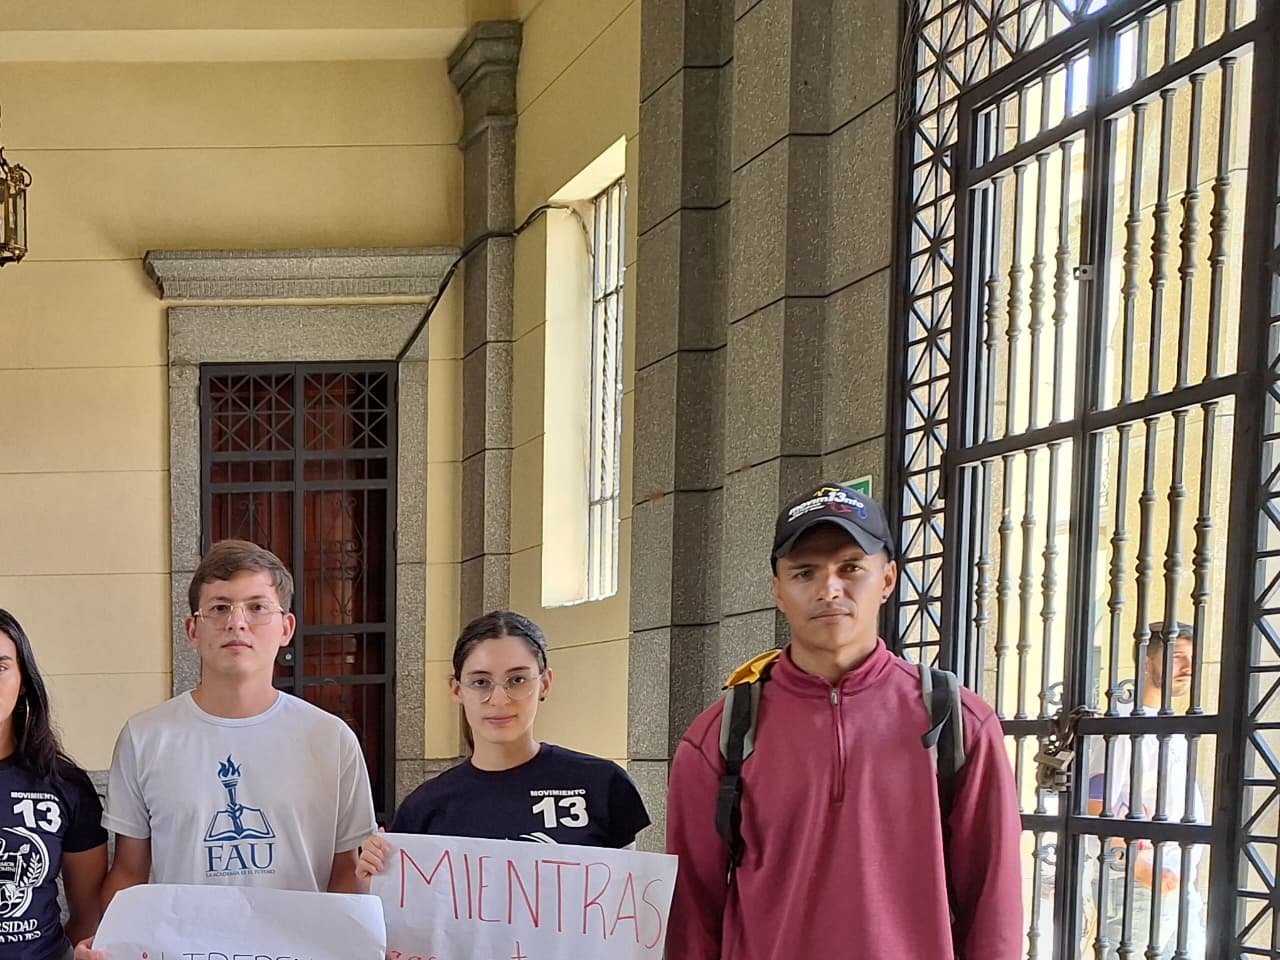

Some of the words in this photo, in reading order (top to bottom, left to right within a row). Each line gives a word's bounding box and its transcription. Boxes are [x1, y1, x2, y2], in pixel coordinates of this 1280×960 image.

[530, 789, 587, 797] MOVIMIENTO
[13, 799, 62, 833] 13
[532, 796, 589, 828] 13
[203, 842, 276, 872] FAU
[399, 848, 665, 950] MIENTRAS
